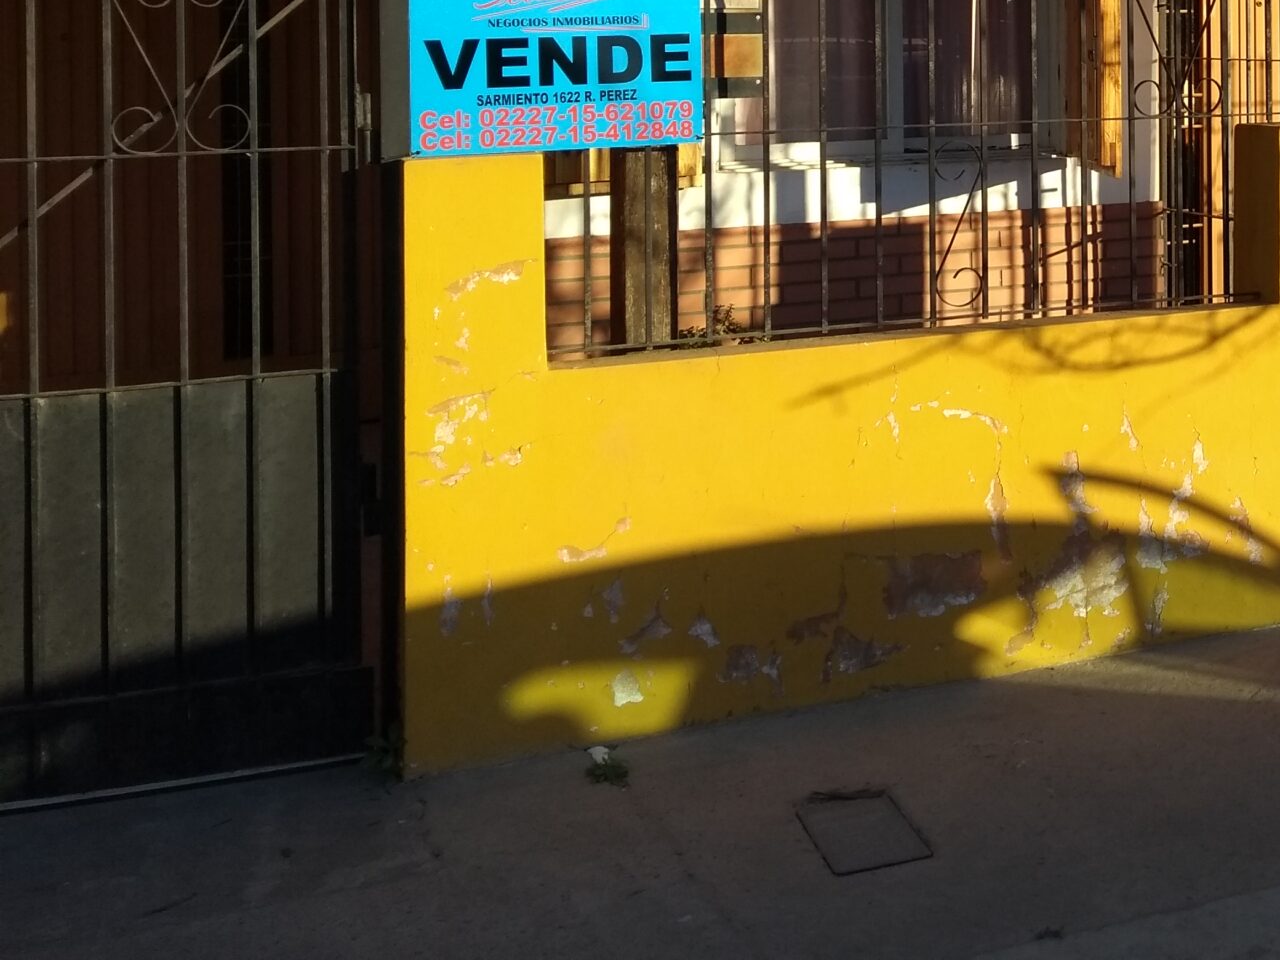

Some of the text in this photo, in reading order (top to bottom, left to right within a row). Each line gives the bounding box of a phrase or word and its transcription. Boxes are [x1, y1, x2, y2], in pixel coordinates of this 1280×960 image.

[487, 14, 640, 28] NEGOCIOS INMOBILIARIOS
[424, 33, 692, 90] VENDE
[476, 89, 637, 107] SARMIENTO 1622 R. PEREZ
[419, 100, 693, 130] Cel: 02227-15-621079
[419, 120, 693, 151] Cel: 02227-15-412848
